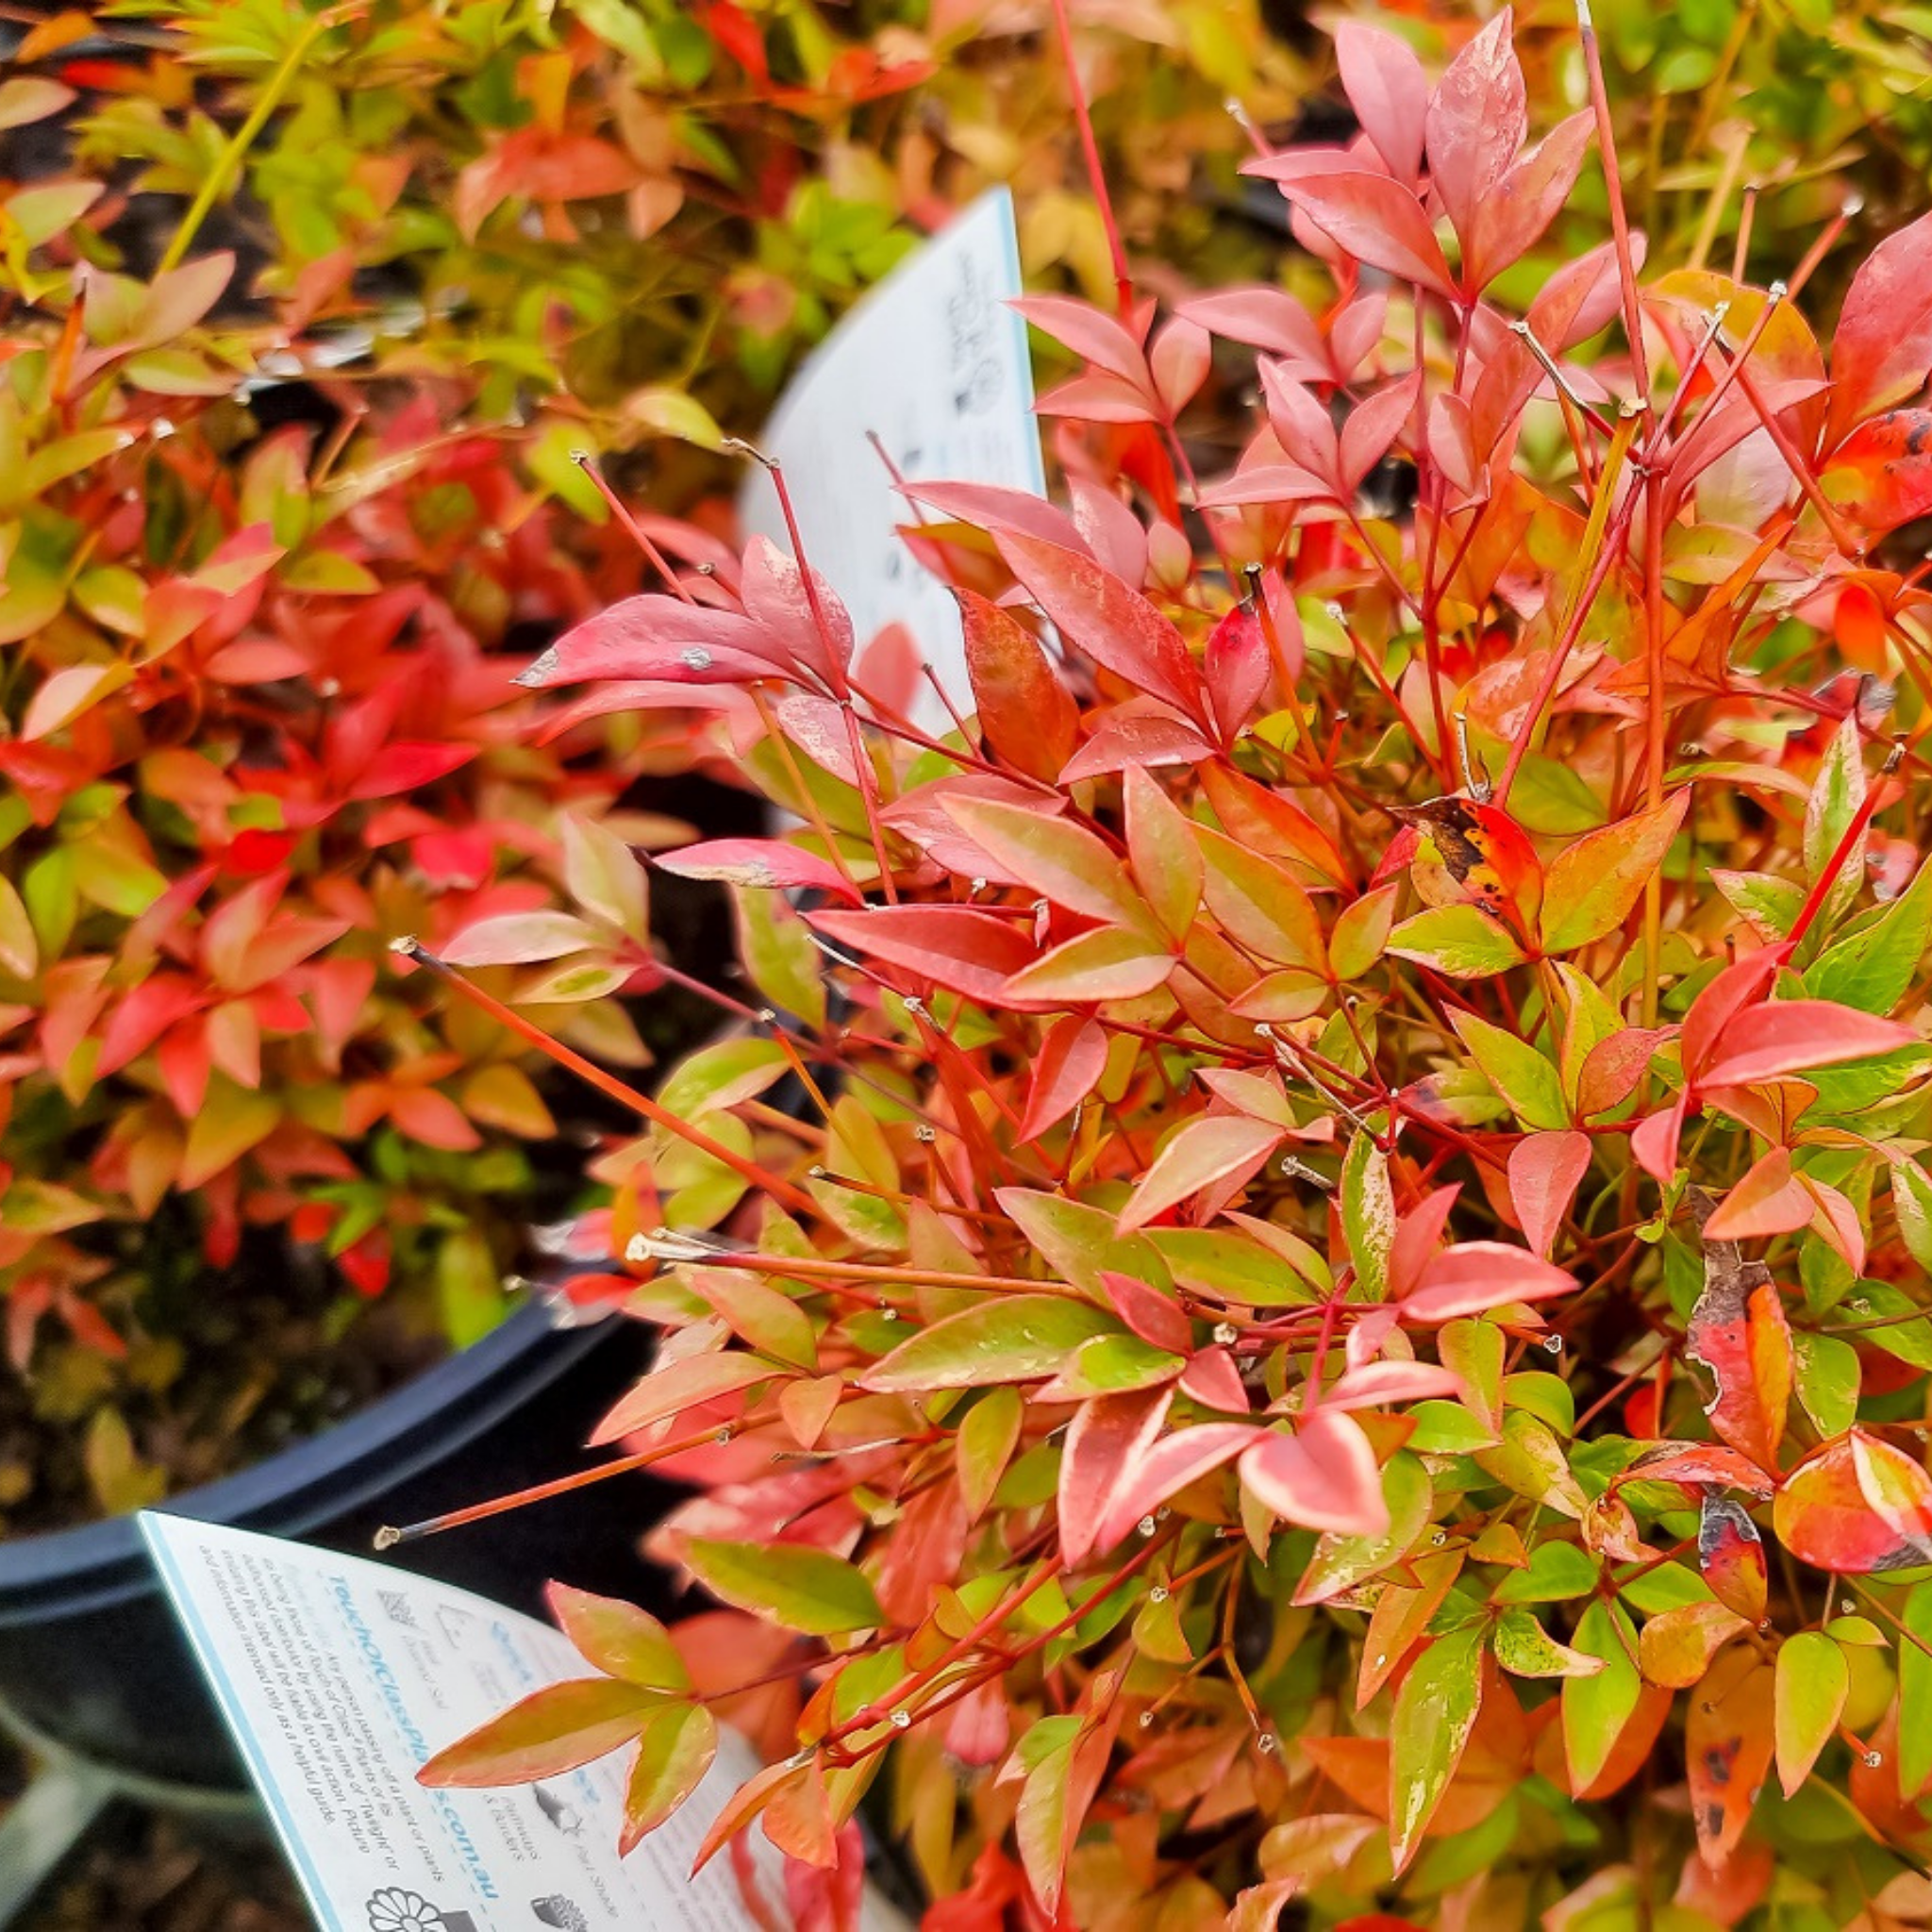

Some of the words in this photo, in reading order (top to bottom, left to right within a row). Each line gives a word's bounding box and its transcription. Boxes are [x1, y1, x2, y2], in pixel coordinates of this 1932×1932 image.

[208, 1568, 250, 1632] information
[238, 1633, 275, 1684] intended
[284, 1741, 323, 1786] helpful
[252, 1619, 278, 1649] label
[339, 1808, 375, 1854] Picture
[264, 1573, 295, 1605] being
[284, 1607, 309, 1637] those
[307, 1654, 335, 1688] Touch
[351, 1746, 381, 1783] Plants
[300, 1688, 331, 1720] using
[330, 1744, 358, 1779] name
[327, 1575, 500, 1899] TouchOfClassPlas.com.au
[333, 1674, 364, 1716] person
[354, 1718, 387, 1764] passing
[391, 1795, 420, 1826] plant
[415, 1844, 446, 1882] plants
[490, 1808, 527, 1862] Borders
